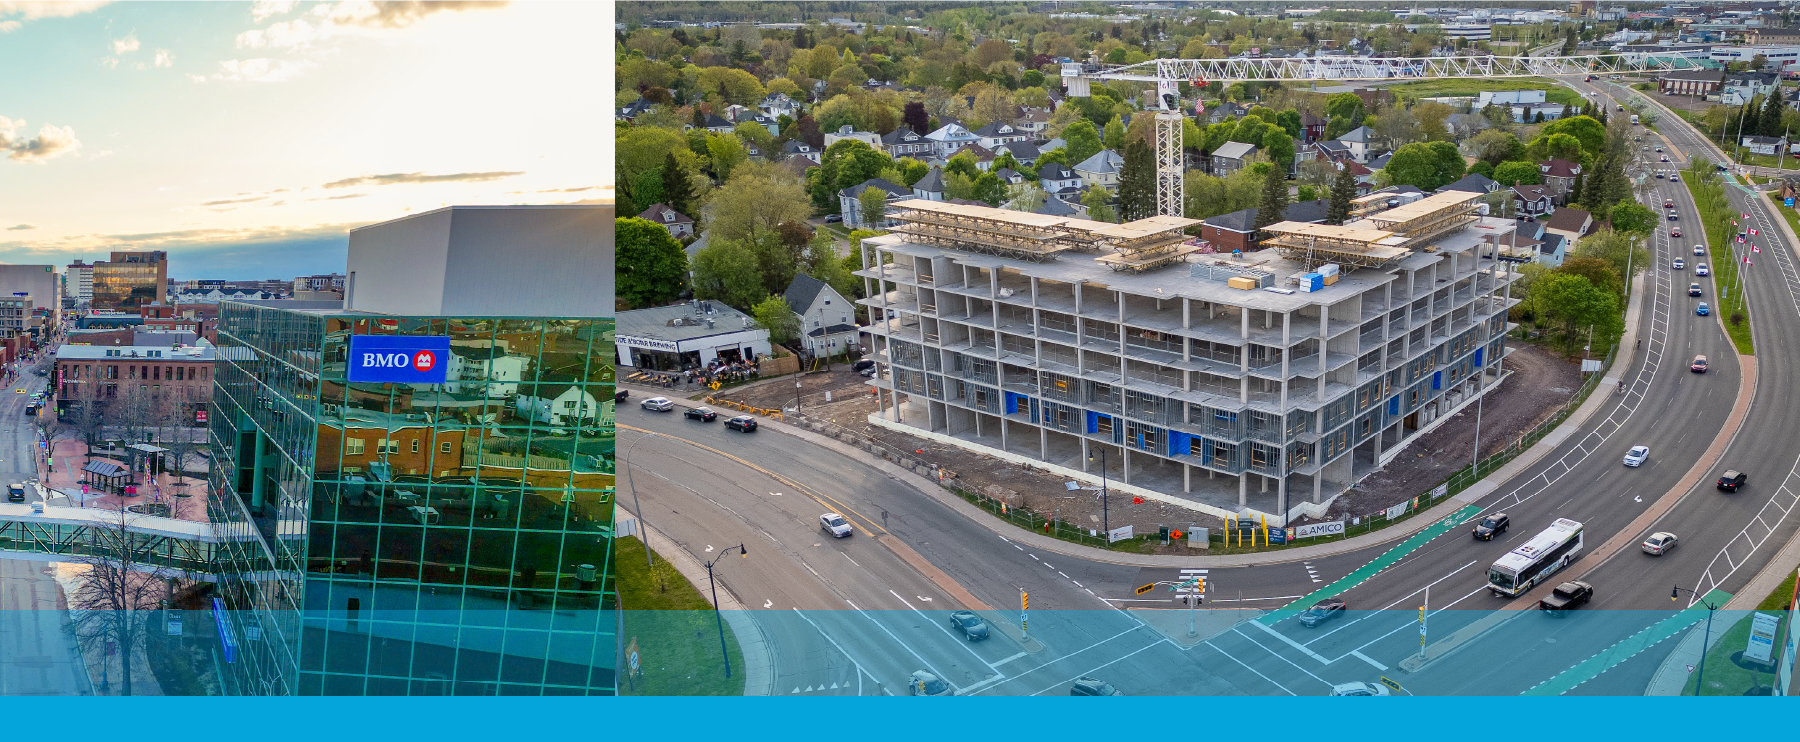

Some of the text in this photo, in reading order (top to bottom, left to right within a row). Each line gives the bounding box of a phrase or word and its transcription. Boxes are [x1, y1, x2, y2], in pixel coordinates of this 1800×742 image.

[649, 341, 676, 350] BREWING
[361, 352, 410, 368] BMO
[1309, 523, 1342, 536] AMICO
